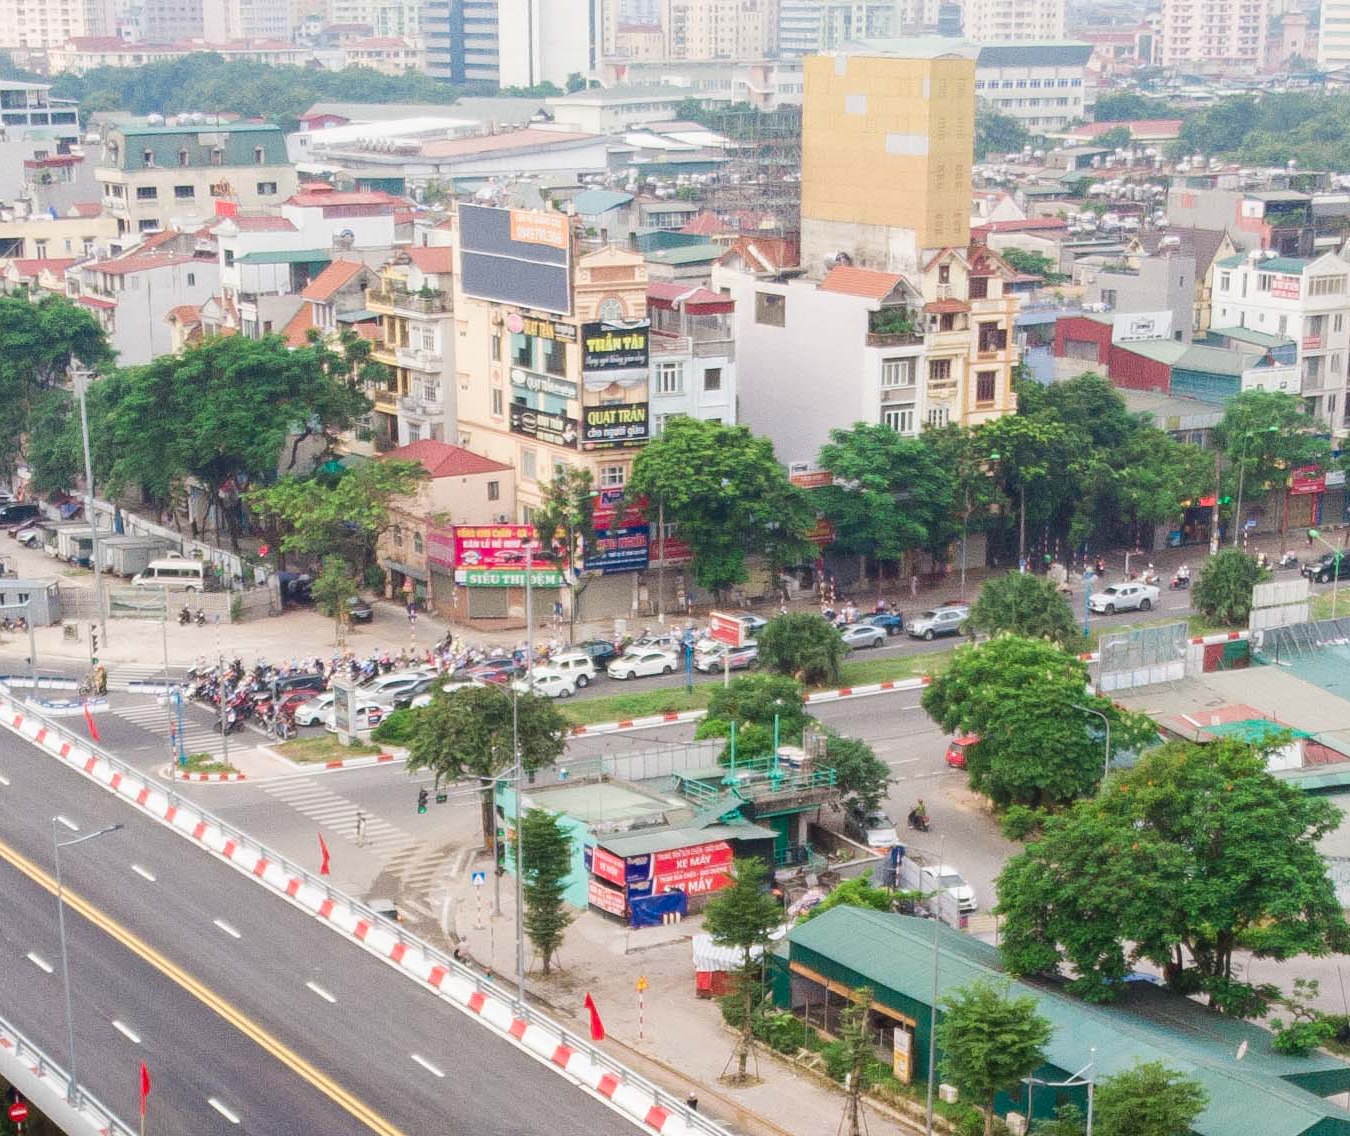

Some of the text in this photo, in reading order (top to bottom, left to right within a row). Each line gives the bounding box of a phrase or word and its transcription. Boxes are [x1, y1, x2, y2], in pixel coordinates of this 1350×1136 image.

[588, 411, 615, 427] QUẠT
[469, 571, 500, 585] SIÊU
[676, 853, 711, 869] XE MÁY
[688, 876, 713, 894] MÁY
